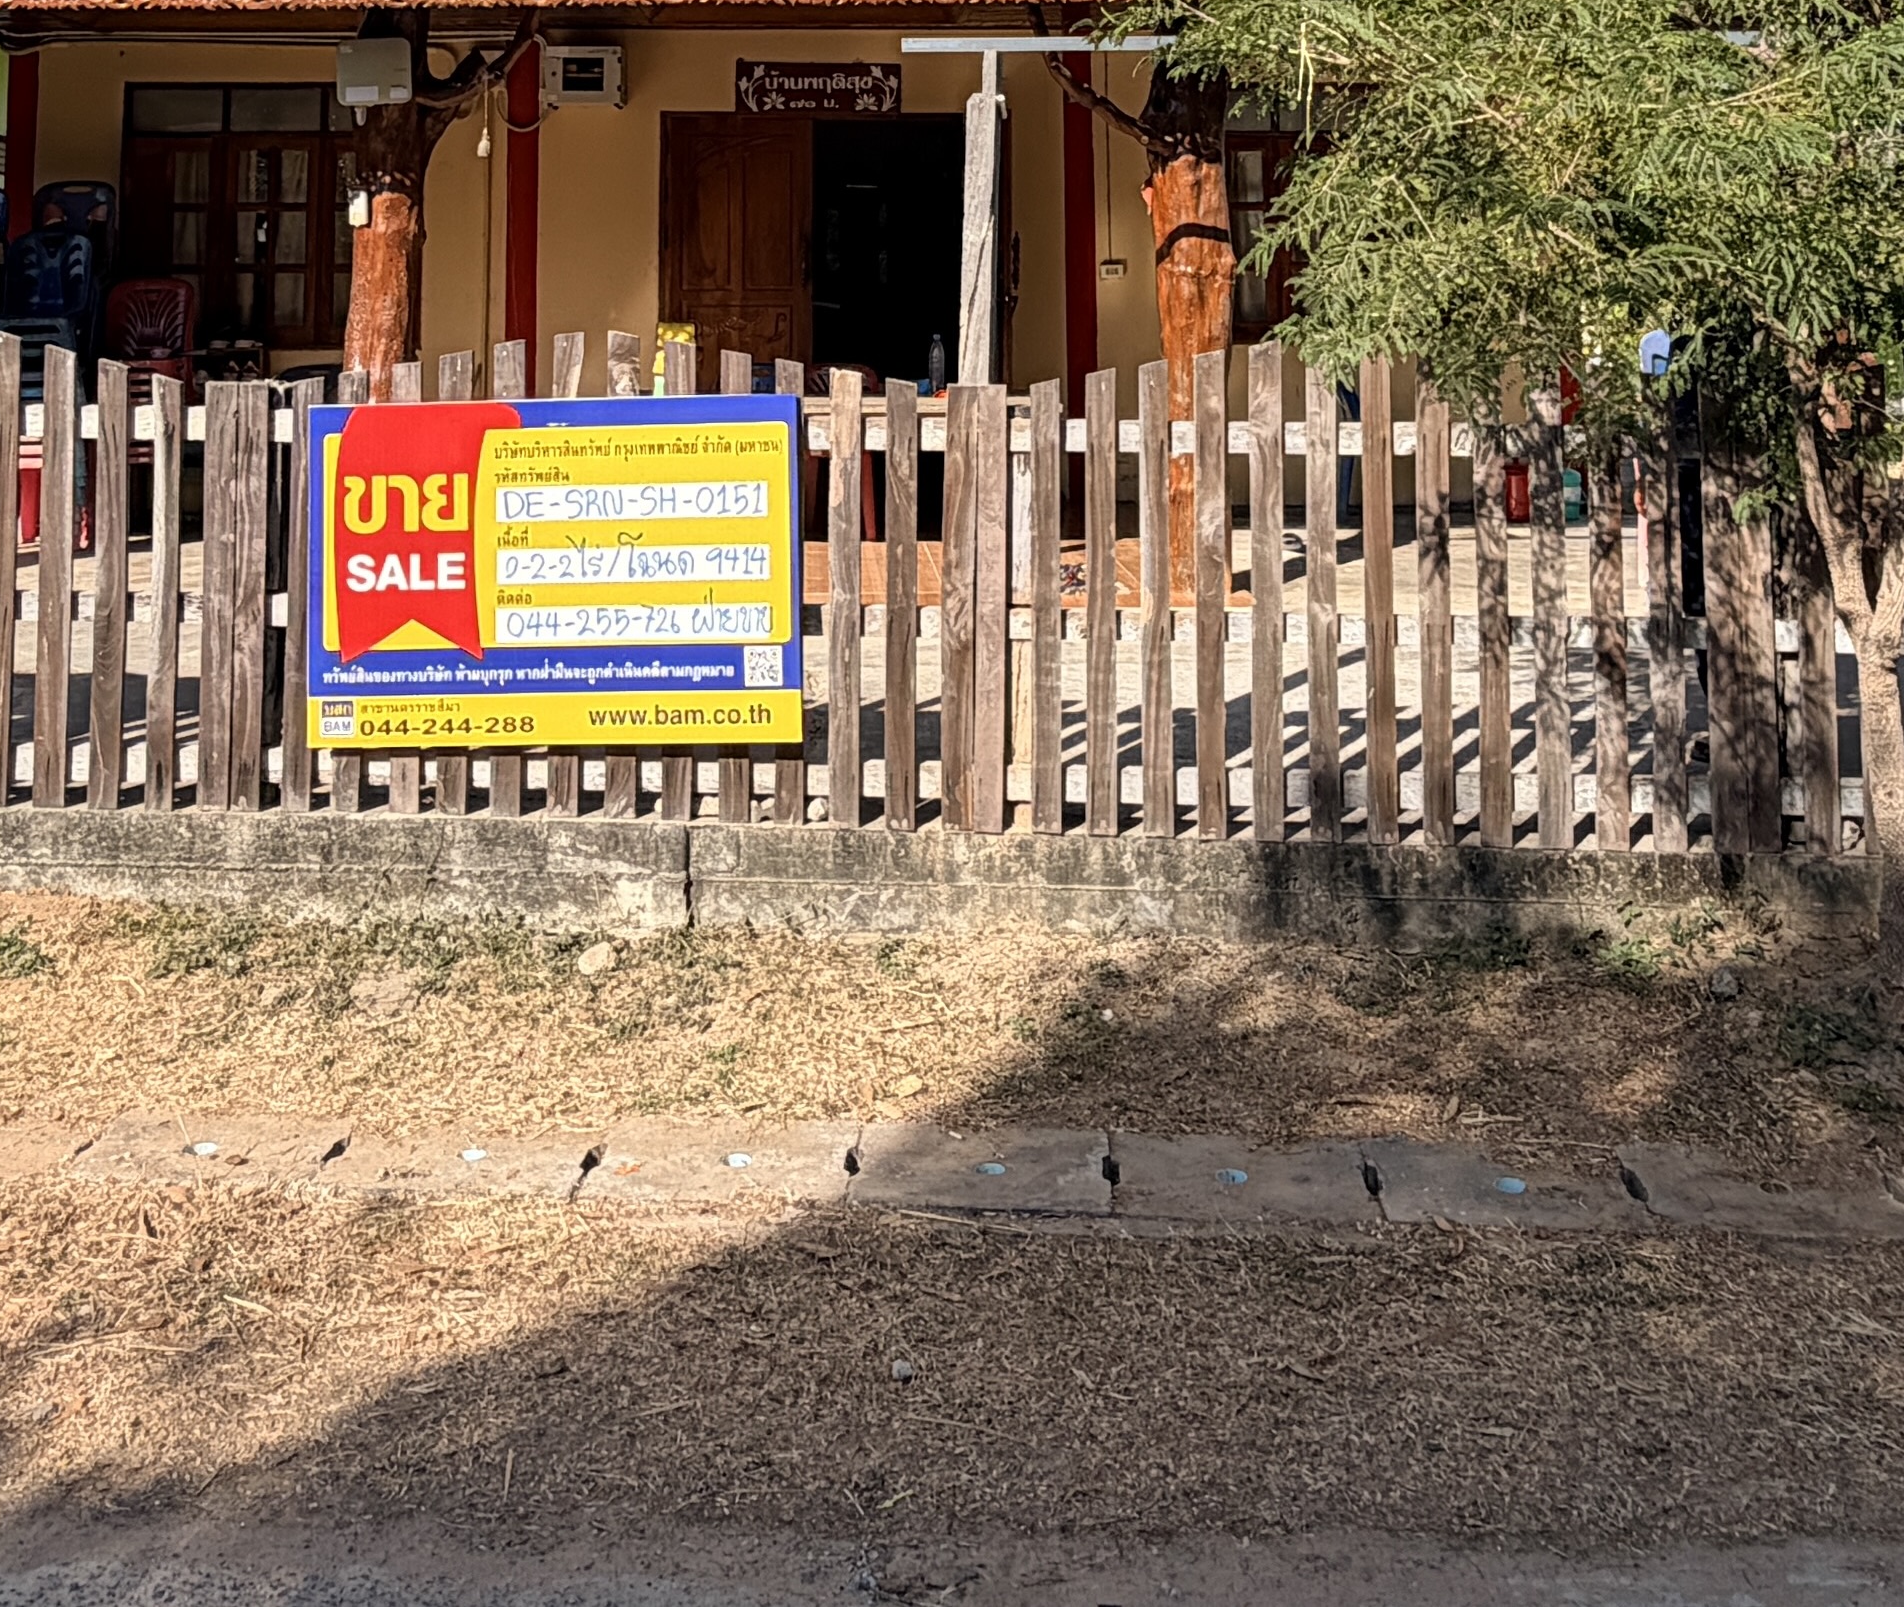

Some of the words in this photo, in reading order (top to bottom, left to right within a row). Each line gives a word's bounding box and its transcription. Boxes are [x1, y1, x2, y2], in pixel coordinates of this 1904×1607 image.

[701, 437, 732, 454] จำกัด
[343, 473, 469, 534] ขาย
[503, 482, 765, 520] DE-SRN-SH-0151
[497, 526, 529, 547] เนื้อที่
[705, 546, 767, 575] 9414
[346, 552, 466, 592] SALE
[496, 589, 532, 605] ติดต่อ
[589, 703, 772, 726] www.bam.co.th
[323, 721, 352, 733] BAM
[360, 716, 535, 736] 044-244-288
